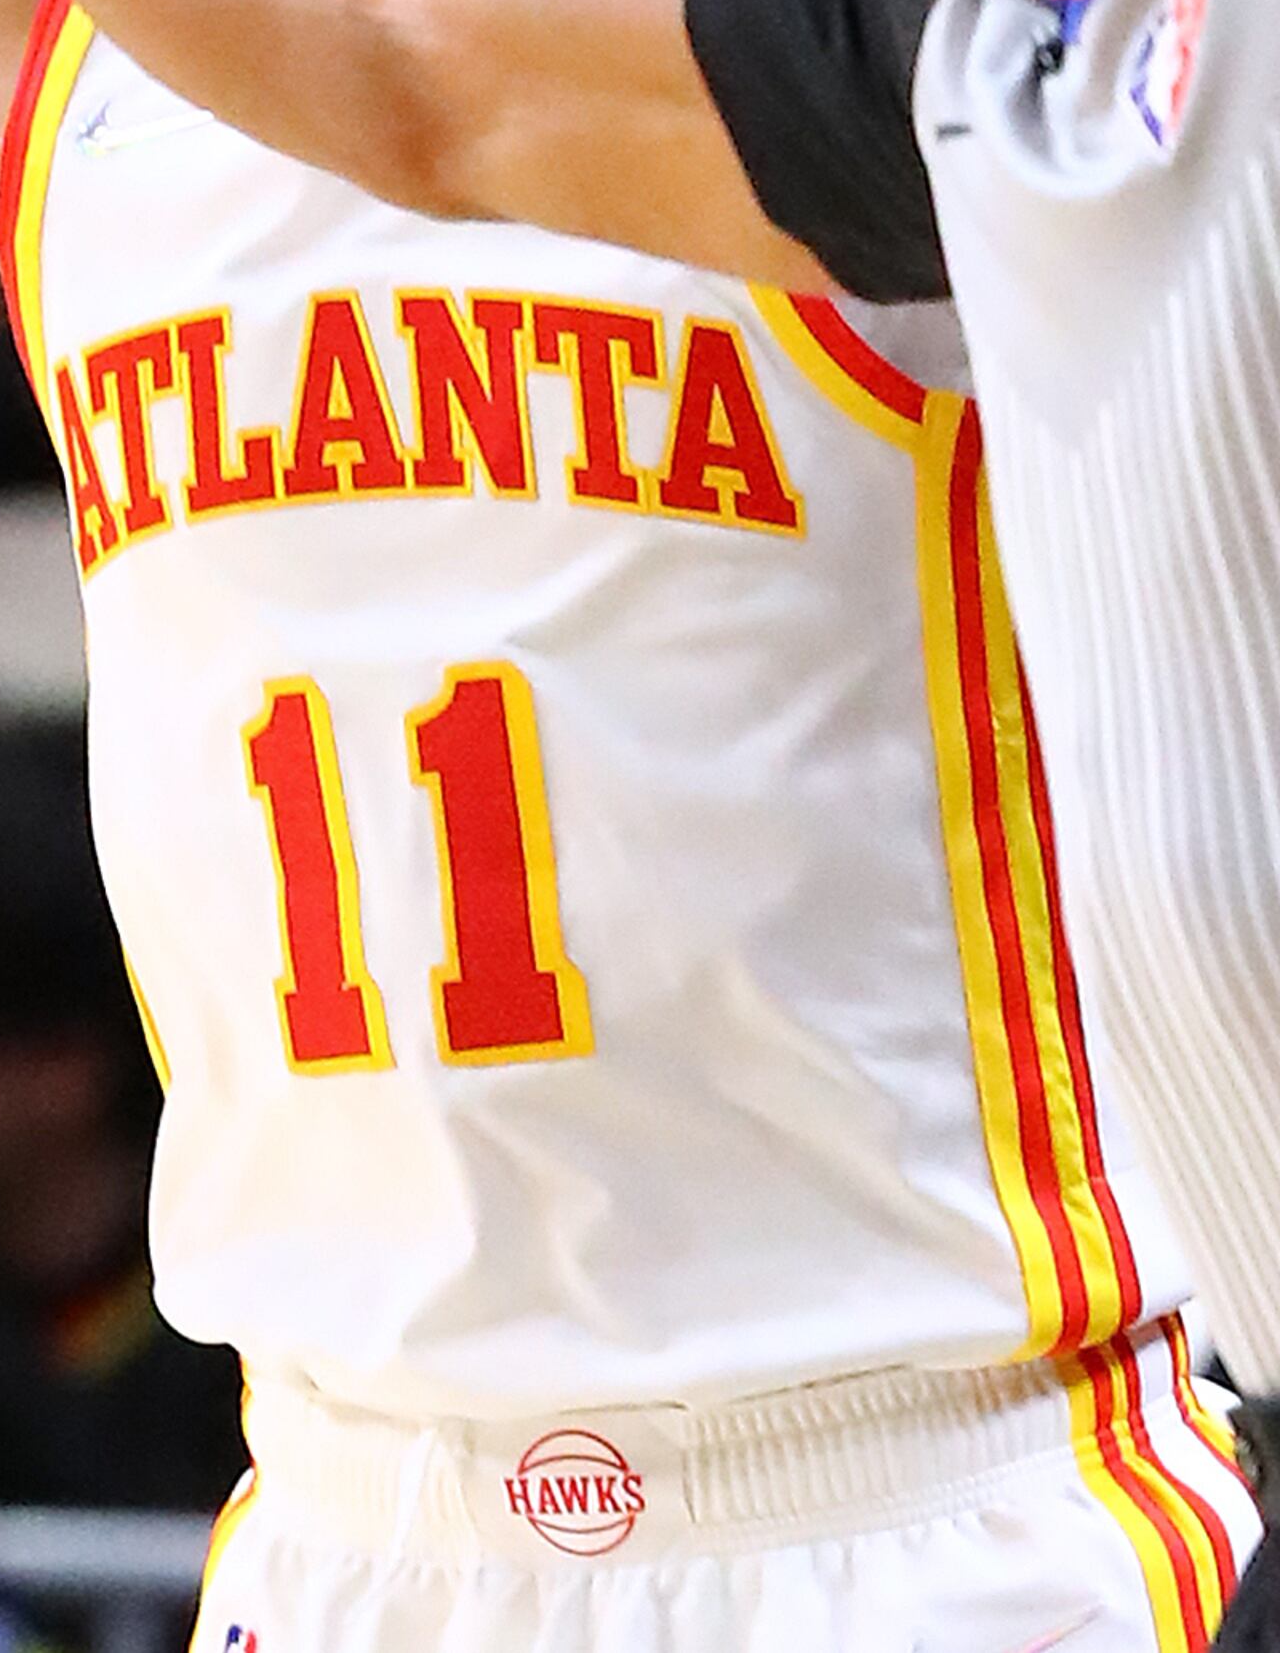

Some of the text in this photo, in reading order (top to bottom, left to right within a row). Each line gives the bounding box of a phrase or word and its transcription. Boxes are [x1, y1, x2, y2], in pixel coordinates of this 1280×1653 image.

[55, 290, 807, 582] ATLANTA
[241, 662, 595, 1075] 11
[503, 1474, 646, 1515] HAWKS
